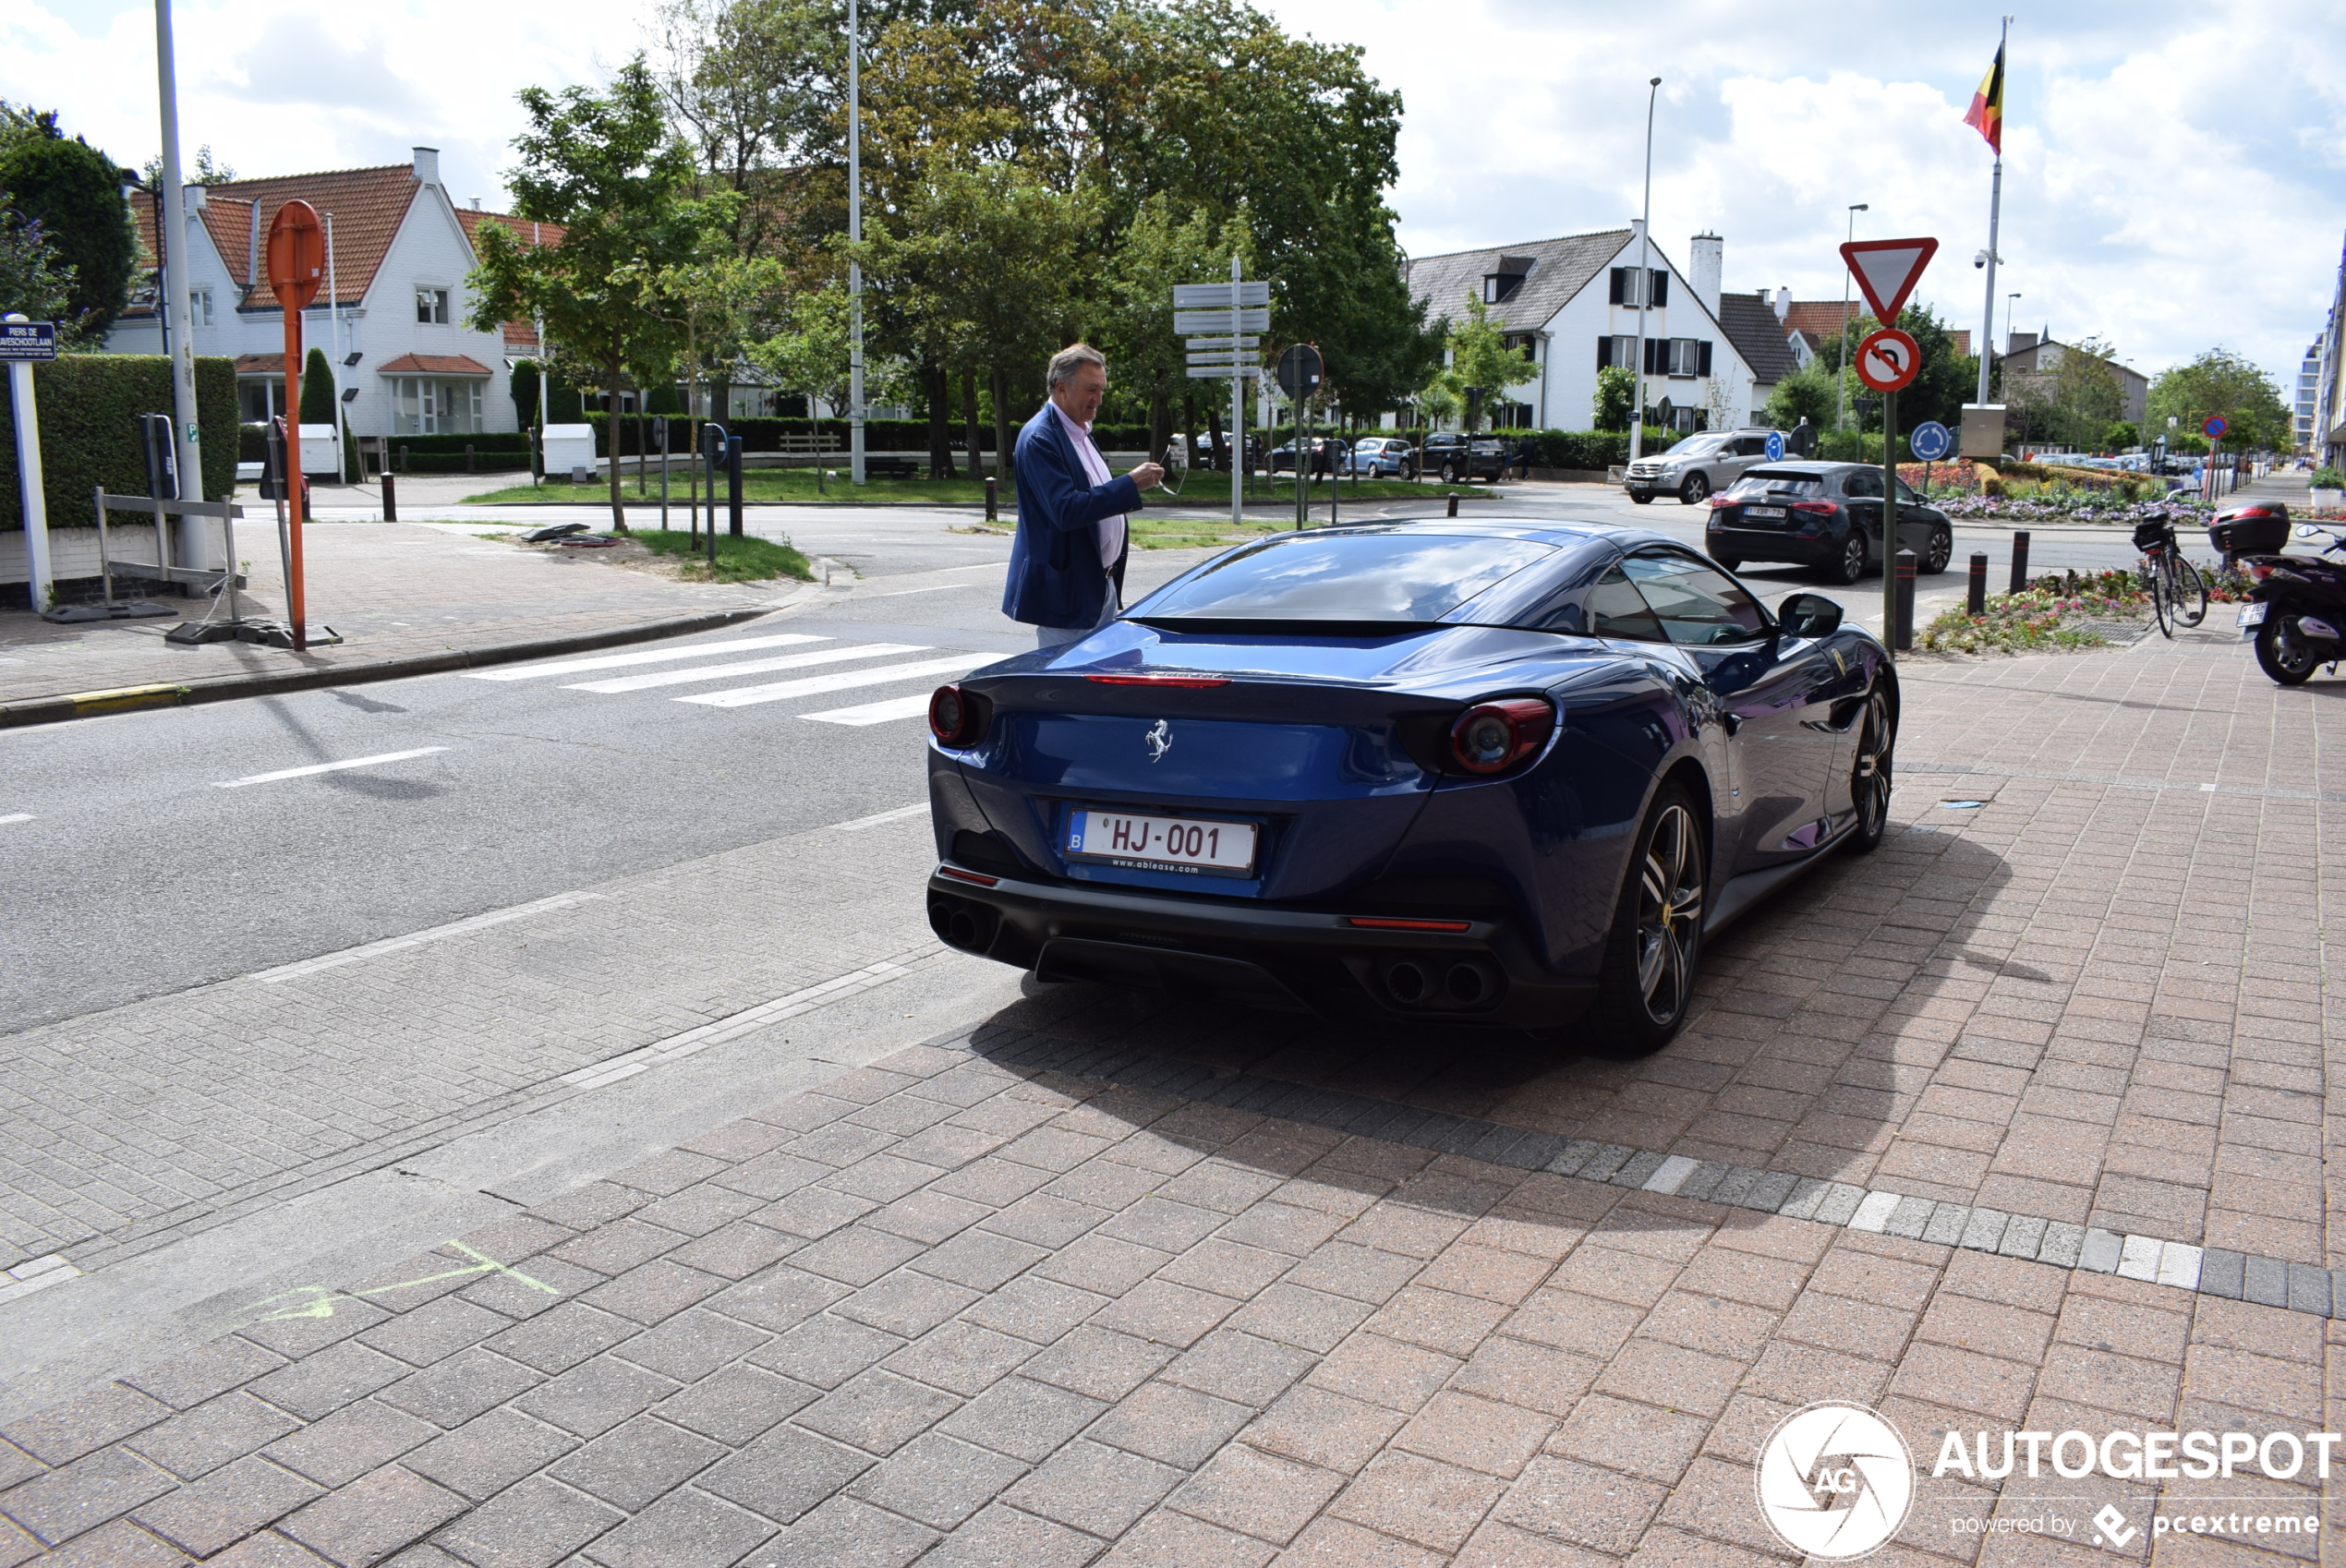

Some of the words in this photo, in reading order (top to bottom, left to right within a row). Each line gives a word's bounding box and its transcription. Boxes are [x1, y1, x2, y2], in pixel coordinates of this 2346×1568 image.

[8, 327, 27, 336] PIERS
[29, 327, 38, 337] DE
[188, 424, 197, 434] P
[1070, 835, 1081, 849] B
[1111, 819, 1219, 859] HJ-001
[1112, 859, 1199, 874] www.ablease.com
